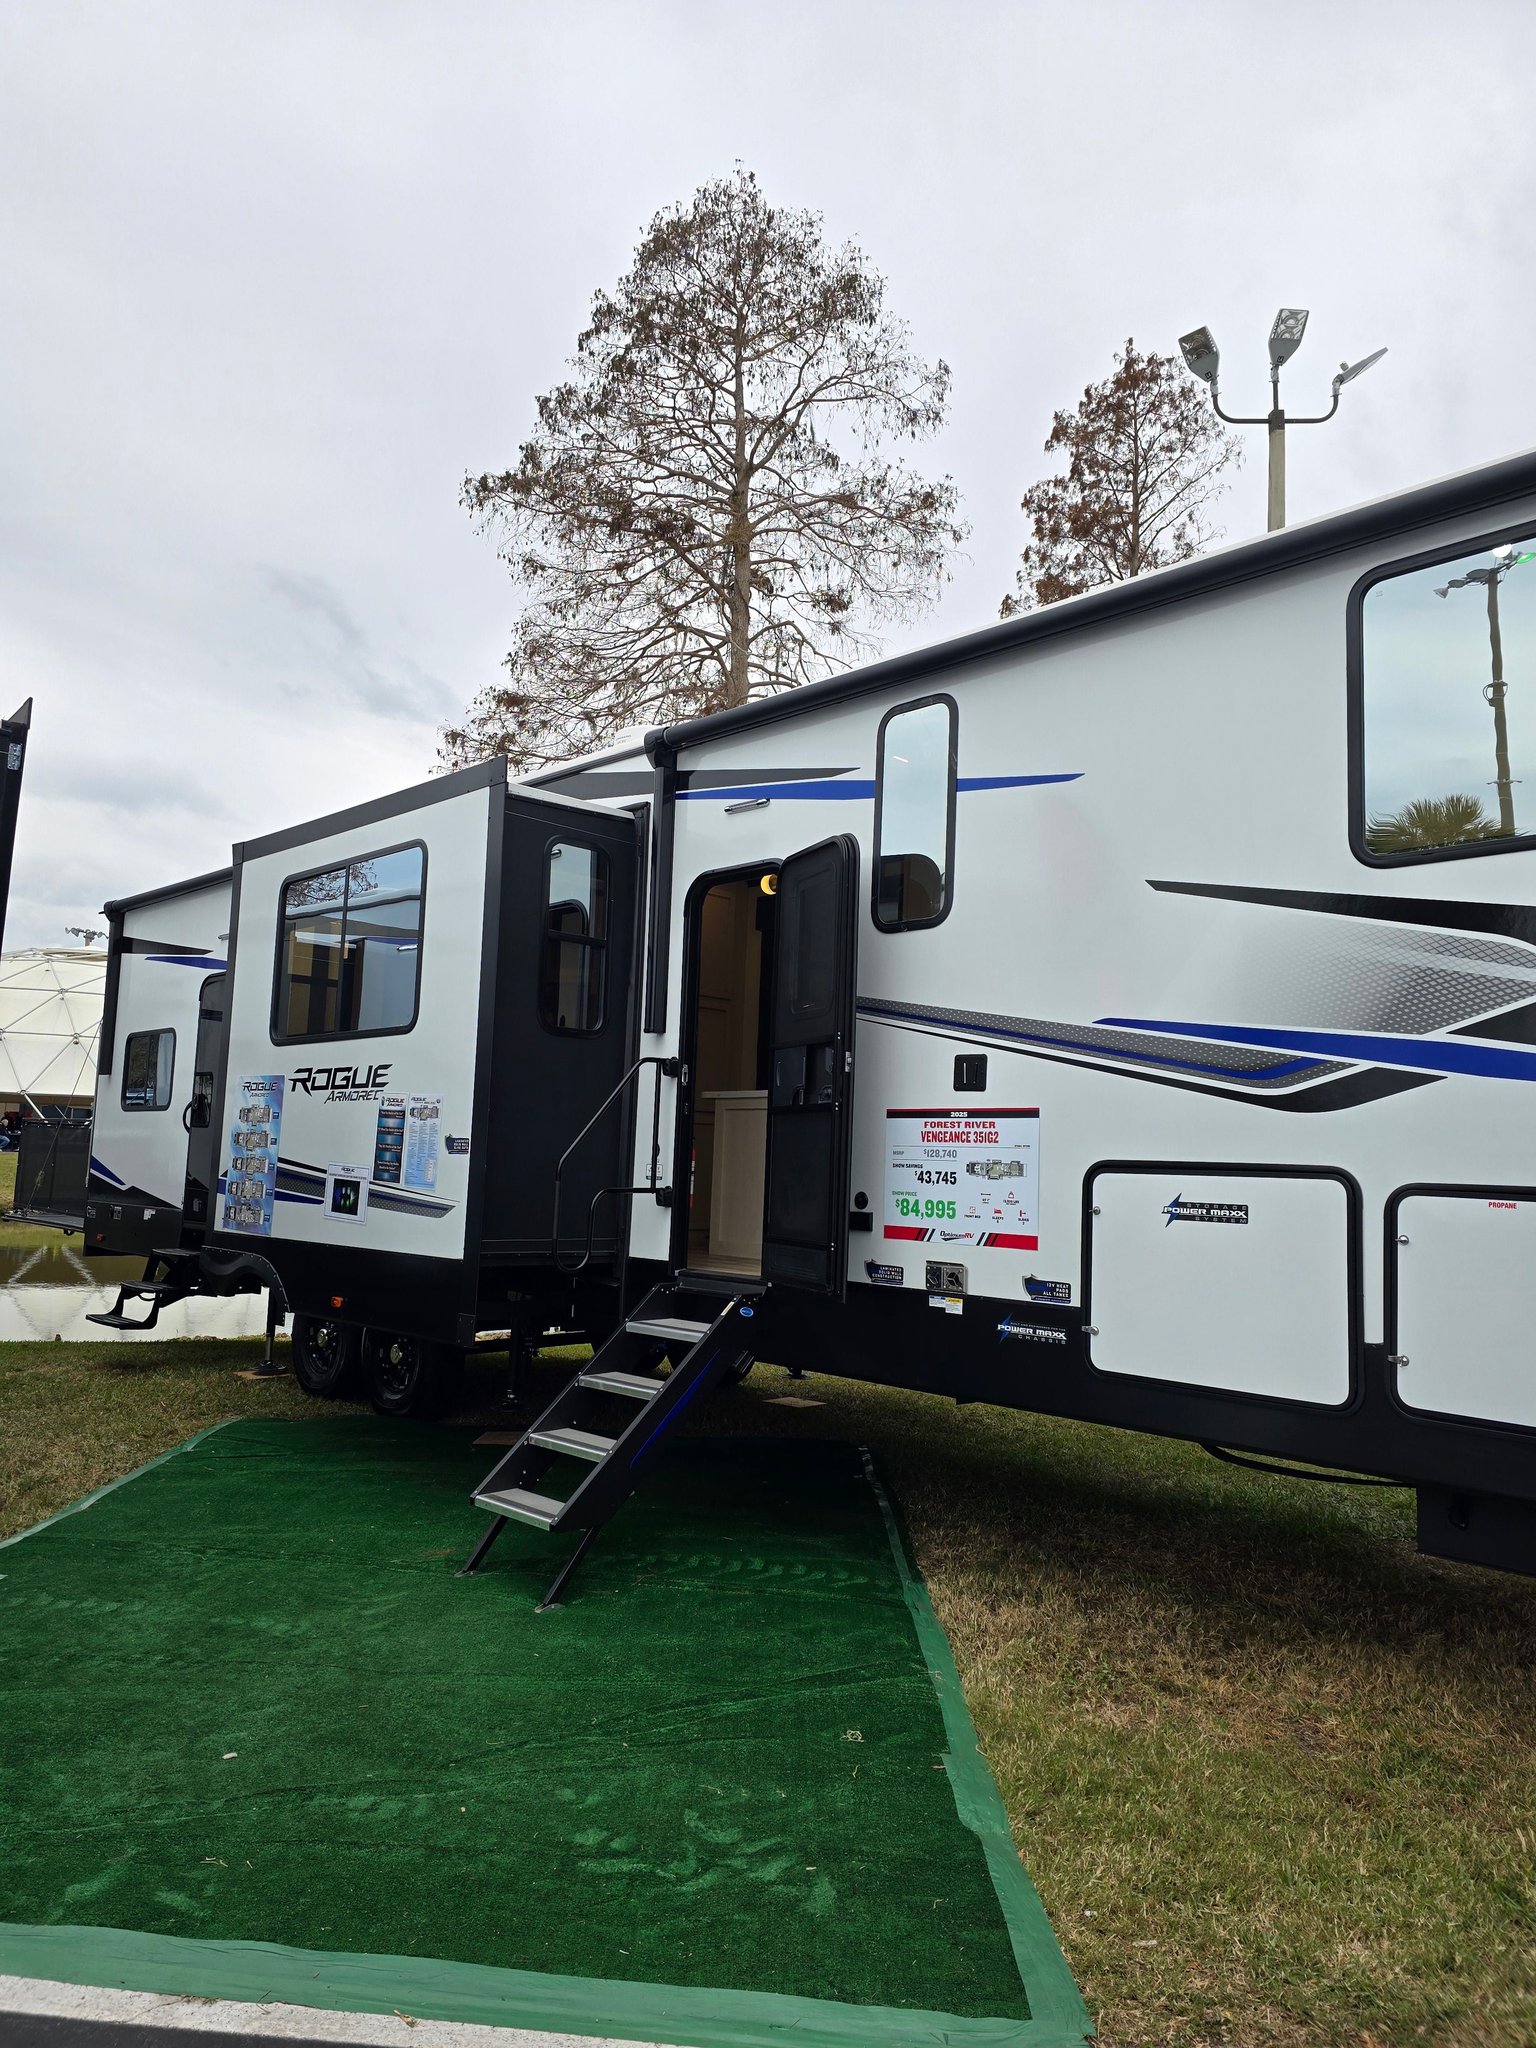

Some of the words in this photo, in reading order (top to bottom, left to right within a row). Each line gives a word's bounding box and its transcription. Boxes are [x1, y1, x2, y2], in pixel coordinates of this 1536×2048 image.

[288, 1064, 393, 1097] ROGUE
[242, 1082, 278, 1093] ROGUE
[924, 1121, 962, 1129] FOREST
[964, 1121, 996, 1129] RIVER
[920, 1130, 972, 1144] VENGEANCE
[923, 1149, 958, 1159] $128,740
[914, 1170, 957, 1186] $43,745
[895, 1198, 957, 1220] $84,995
[1164, 1207, 1207, 1215] POWER
[1210, 1209, 1248, 1218] MAXX
[1187, 1203, 1247, 1211] STORAGE
[1195, 1216, 1247, 1224] SYSTEM
[997, 1324, 1033, 1335] POWER
[1036, 1329, 1067, 1340] MAXX
[1018, 1334, 1066, 1345] CHASSIS
